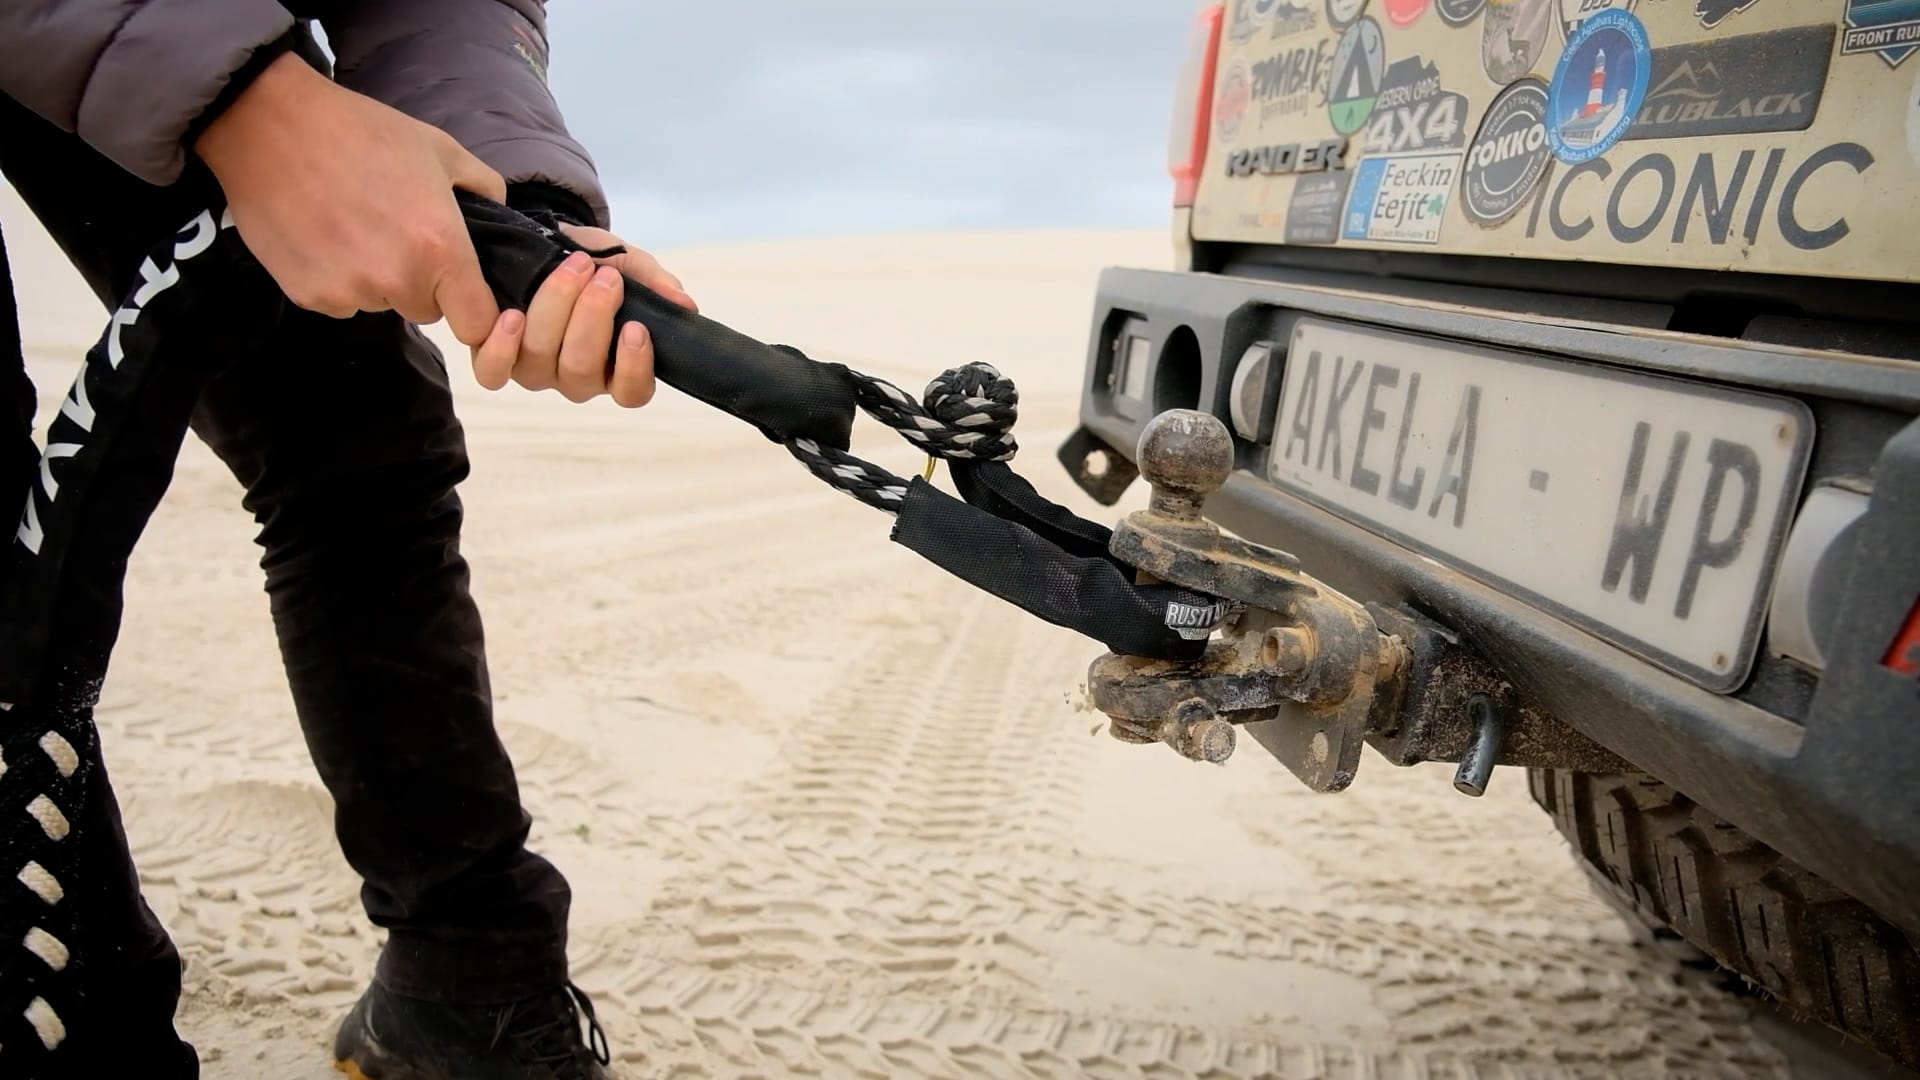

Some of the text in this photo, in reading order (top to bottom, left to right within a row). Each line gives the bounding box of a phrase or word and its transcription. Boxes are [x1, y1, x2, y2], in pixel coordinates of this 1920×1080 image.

[1847, 29, 1895, 47] FRONT
[1366, 95, 1459, 153] 4X4
[1631, 91, 1812, 126] LUBLACK
[1225, 138, 1349, 178] RAIDER
[1382, 162, 1452, 186] Feckin
[1373, 191, 1430, 228] Eejit
[1525, 142, 1875, 251] ICONIC
[1284, 349, 1482, 529] AKELA
[1600, 420, 1761, 621] WP
